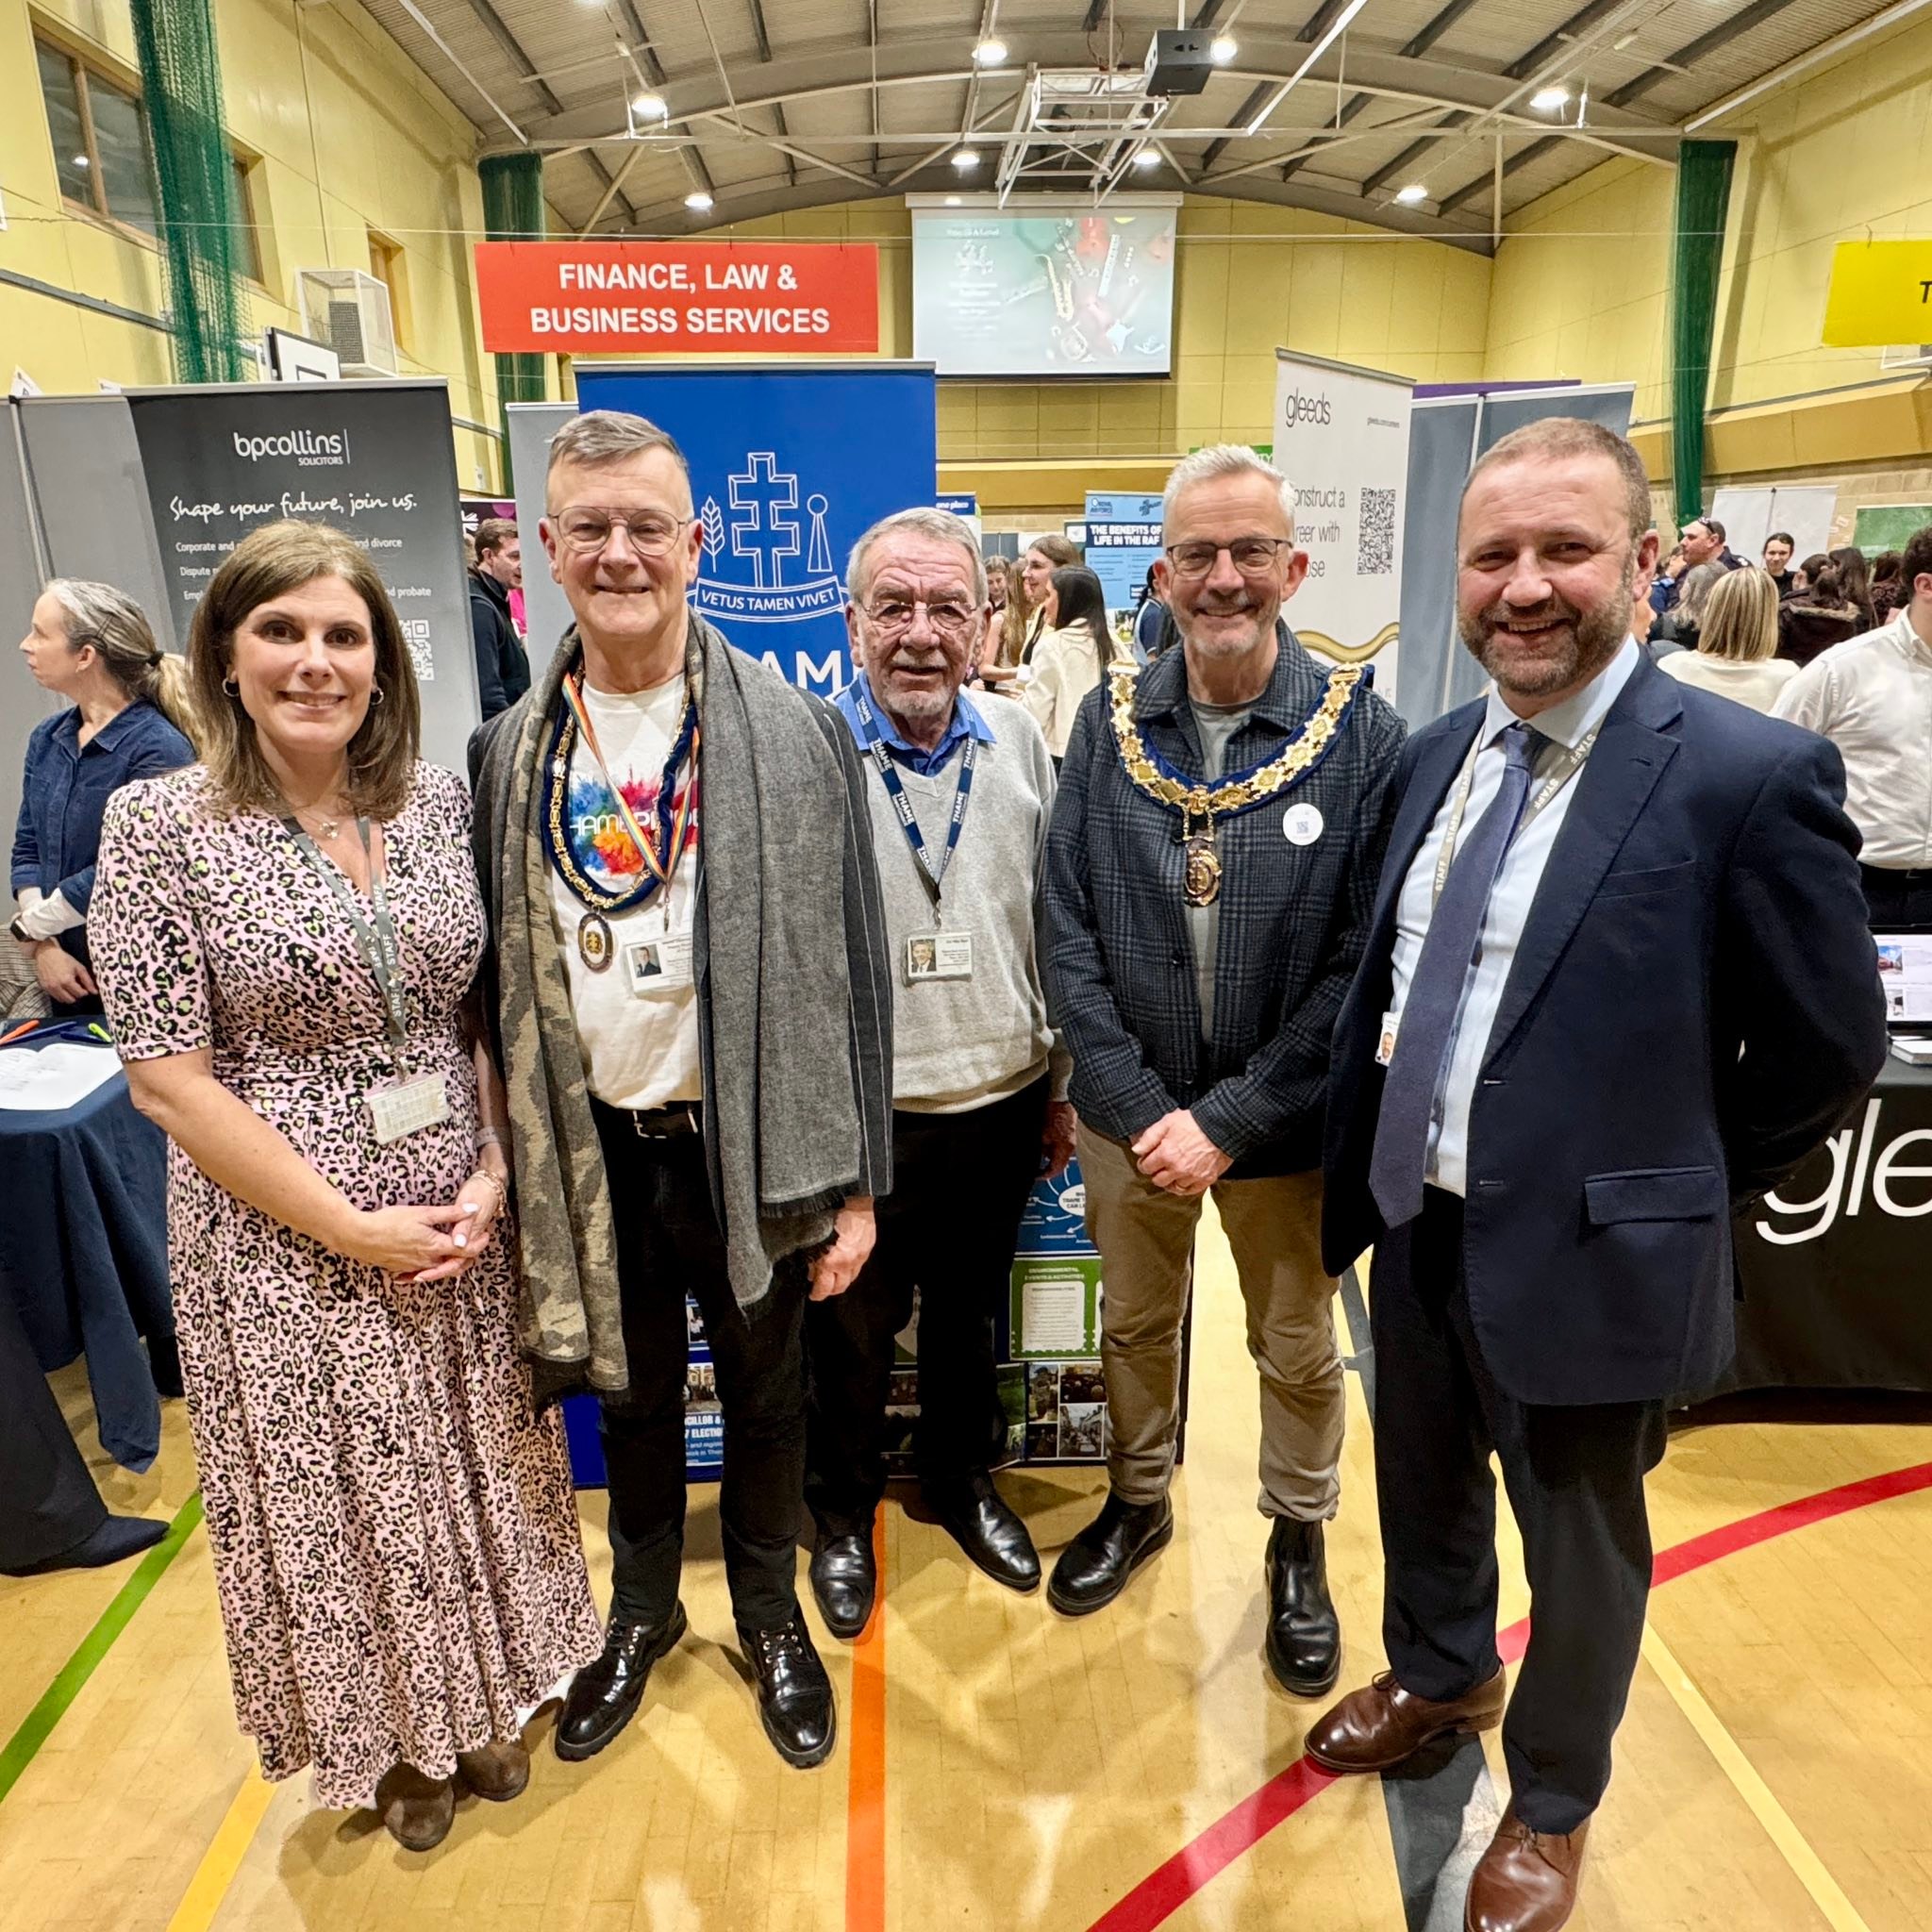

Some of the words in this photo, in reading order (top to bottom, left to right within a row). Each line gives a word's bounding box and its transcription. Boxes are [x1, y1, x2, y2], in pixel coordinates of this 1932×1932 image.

[558, 263, 696, 294] FINANCE,
[705, 263, 769, 290] LAW
[776, 264, 798, 290] &
[530, 308, 678, 333] BUSINESS
[686, 308, 830, 333] SERVICES
[1286, 387, 1331, 427] gleeds
[233, 429, 342, 461] bpcollins
[297, 456, 343, 466] SOLICITORS
[170, 495, 224, 524] Shape
[230, 502, 275, 521] your
[280, 491, 344, 518] future,
[348, 492, 388, 517] join
[391, 492, 418, 511] us.
[1339, 490, 1345, 508] a
[371, 538, 402, 548] divorce
[1090, 525, 1108, 535] THE
[1109, 525, 1149, 535] BENEFITS
[1150, 525, 1162, 535] OF
[1094, 535, 1112, 545] LIFE
[1113, 535, 1124, 545] IN
[1124, 535, 1141, 545] THE
[1141, 535, 1160, 545] RAF
[1295, 525, 1315, 542] reer
[1318, 520, 1341, 542] with
[175, 541, 216, 555] Corporate
[218, 541, 234, 552] and
[179, 566, 210, 578] Dispute
[183, 591, 202, 602] Empl
[397, 586, 431, 598] probate
[702, 589, 744, 609] VETUS
[747, 597, 794, 611] TAMEN
[796, 588, 835, 608] VIVET
[760, 650, 843, 693] AM
[873, 738, 893, 770] THAME
[1570, 734, 1596, 764] STAFF
[1534, 778, 1559, 809] STAFF
[896, 791, 916, 824] THAME
[308, 850, 330, 875] STAFF
[1435, 860, 1446, 891] STAFF
[340, 892, 361, 920] STAFF
[373, 884, 386, 913] STAFF
[382, 934, 397, 965] STAFF
[1756, 1098, 1932, 1245] gle
[691, 1427, 723, 1438] ELECTIO
